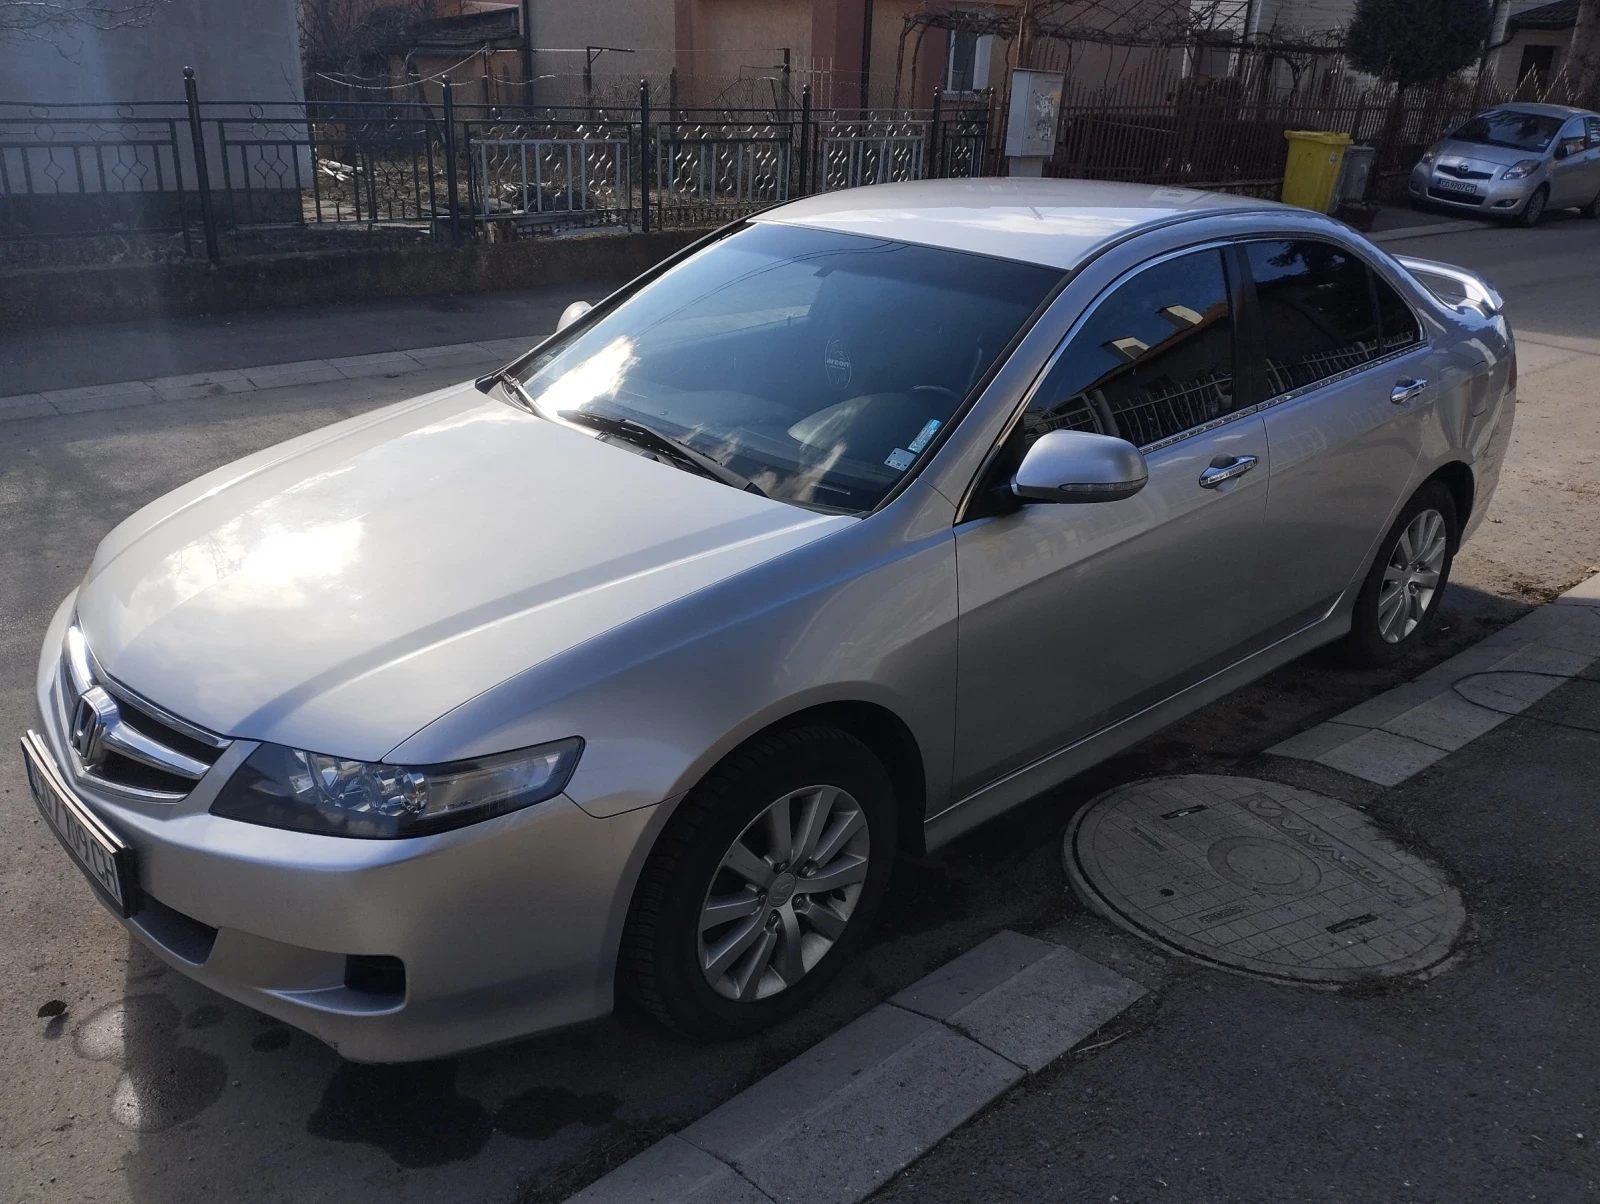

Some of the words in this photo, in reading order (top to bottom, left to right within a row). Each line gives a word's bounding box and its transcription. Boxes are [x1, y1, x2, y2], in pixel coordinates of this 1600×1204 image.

[1450, 181, 1465, 190] 9707
[826, 358, 849, 368] areon
[90, 838, 119, 897] CH
[1281, 817, 1415, 908] VIVACOM
